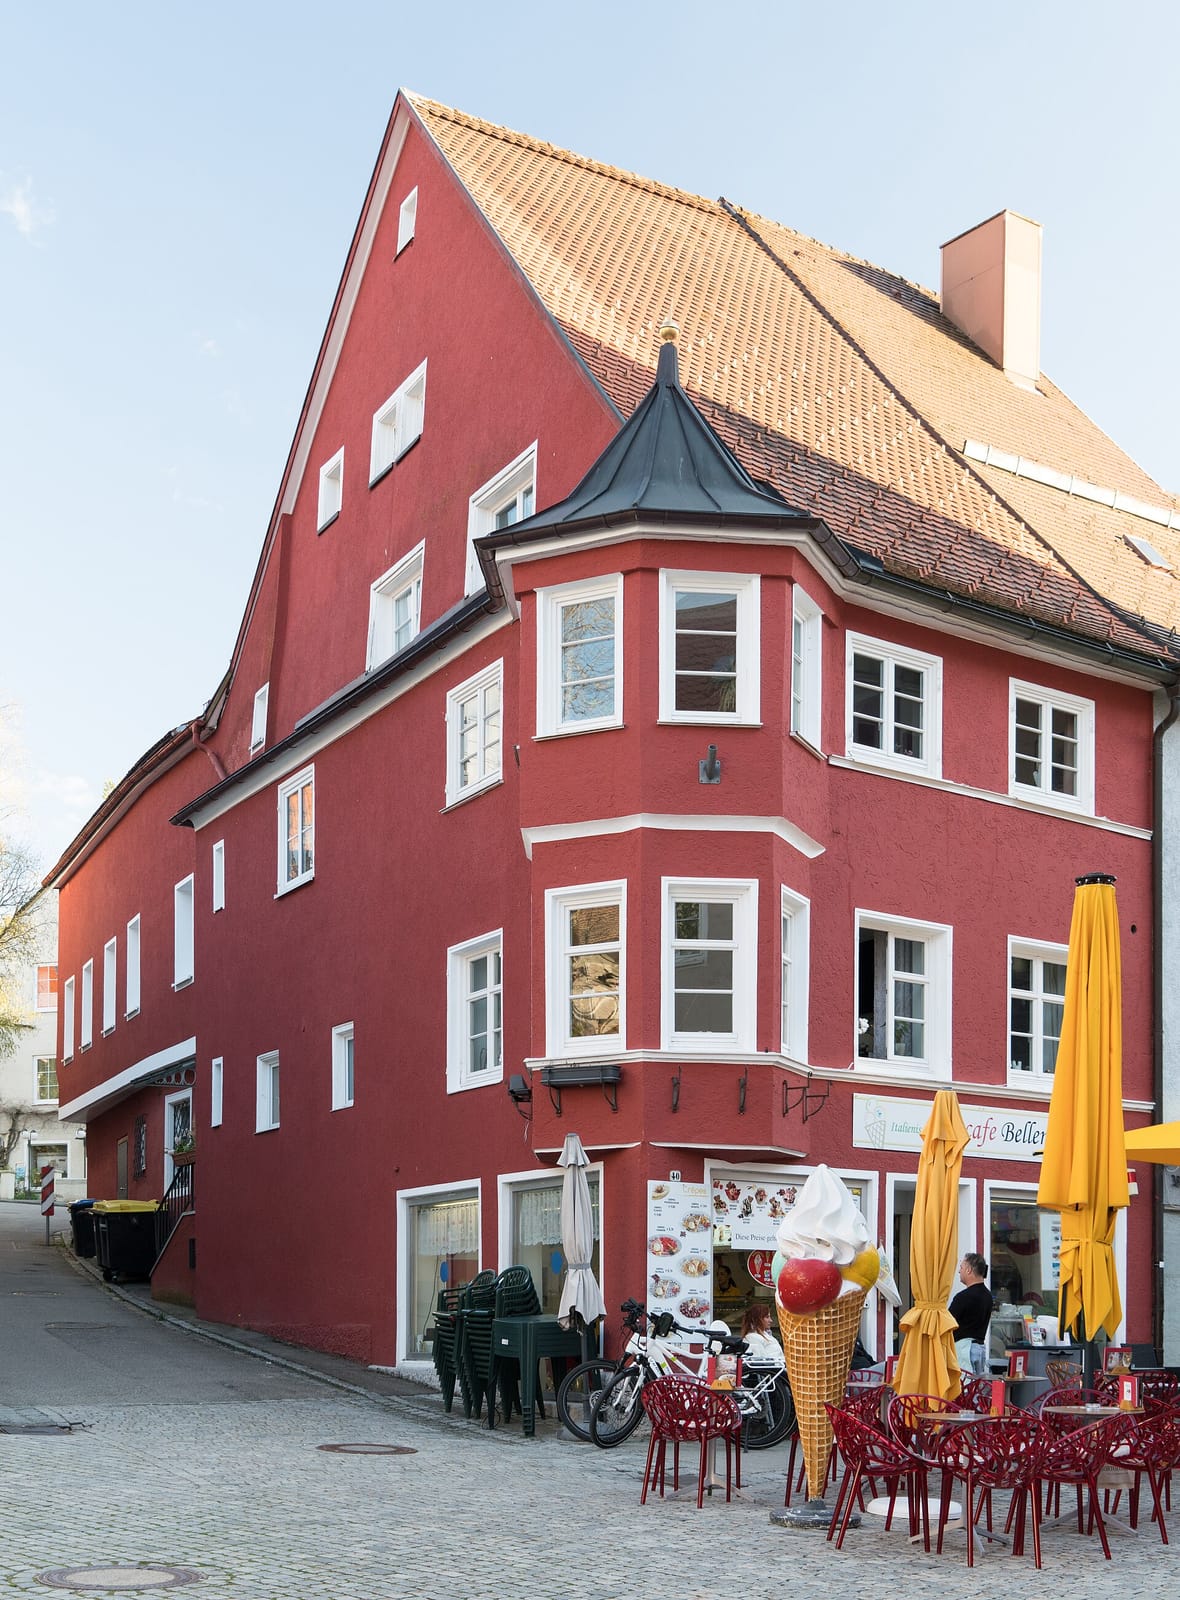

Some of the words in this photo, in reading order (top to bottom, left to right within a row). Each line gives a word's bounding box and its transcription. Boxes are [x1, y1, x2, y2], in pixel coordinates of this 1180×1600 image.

[671, 1172, 680, 1180] 40
[735, 1233, 750, 1241] Diese
[751, 1233, 766, 1241] Preise
